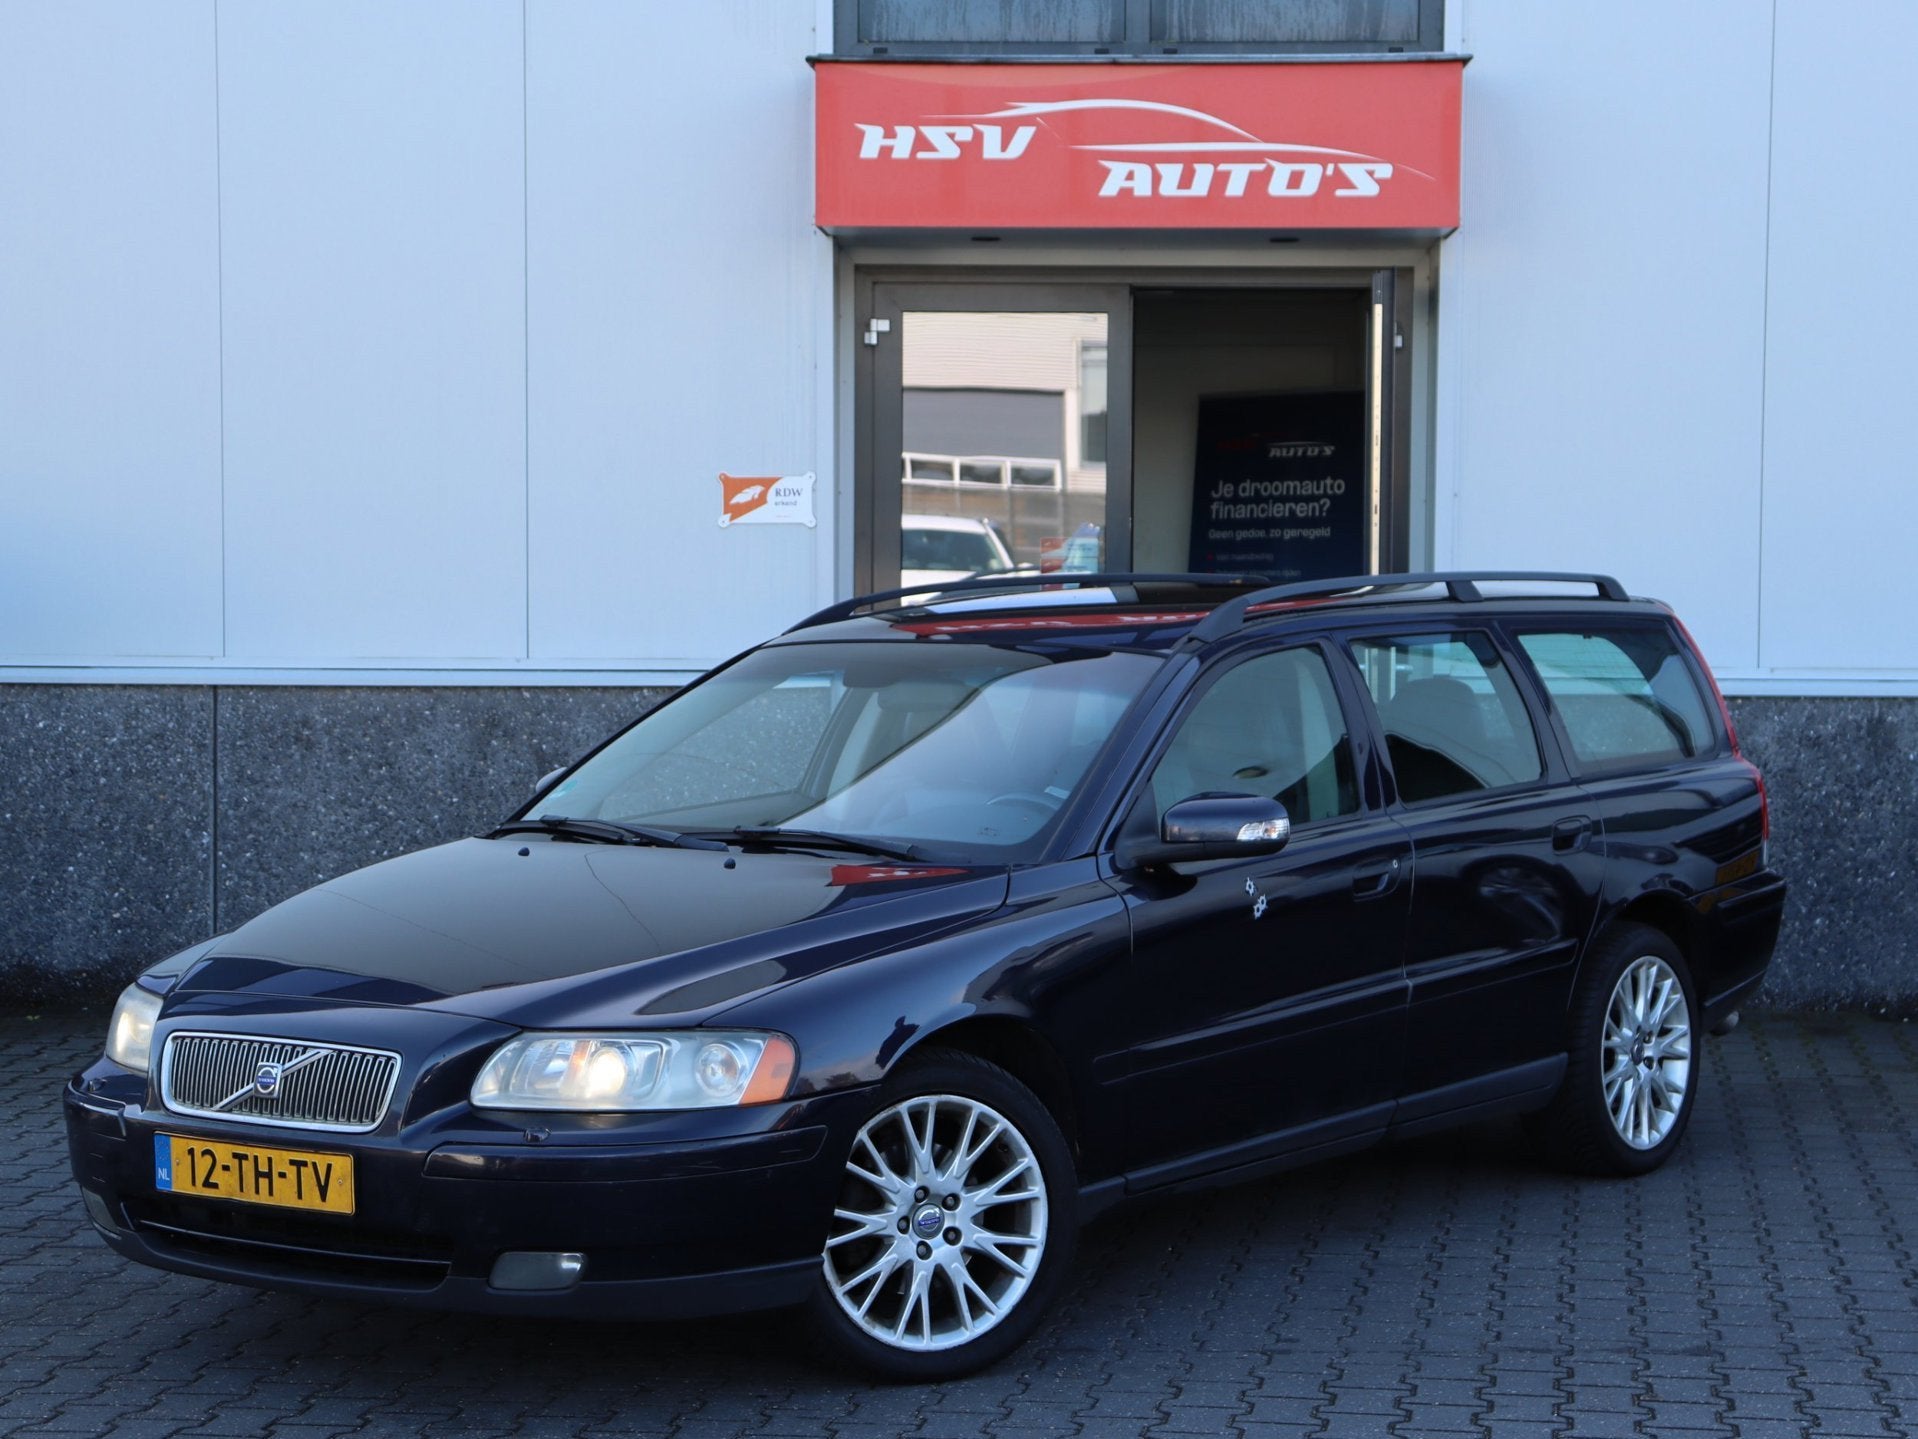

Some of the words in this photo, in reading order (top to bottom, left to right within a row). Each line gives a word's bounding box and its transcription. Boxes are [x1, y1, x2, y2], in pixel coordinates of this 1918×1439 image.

[855, 122, 1037, 160] HSV
[1098, 157, 1394, 198] AUTO'S
[775, 487, 804, 497] RDW
[1210, 479, 1235, 498] Je
[1238, 476, 1346, 497] droomauto
[1210, 498, 1331, 519] financieren?
[1208, 528, 1234, 539] Geen
[1269, 527, 1281, 538] zo
[1283, 525, 1331, 540] geregeld
[157, 1168, 170, 1181] NL
[187, 1147, 333, 1203] 12-TH-TV
